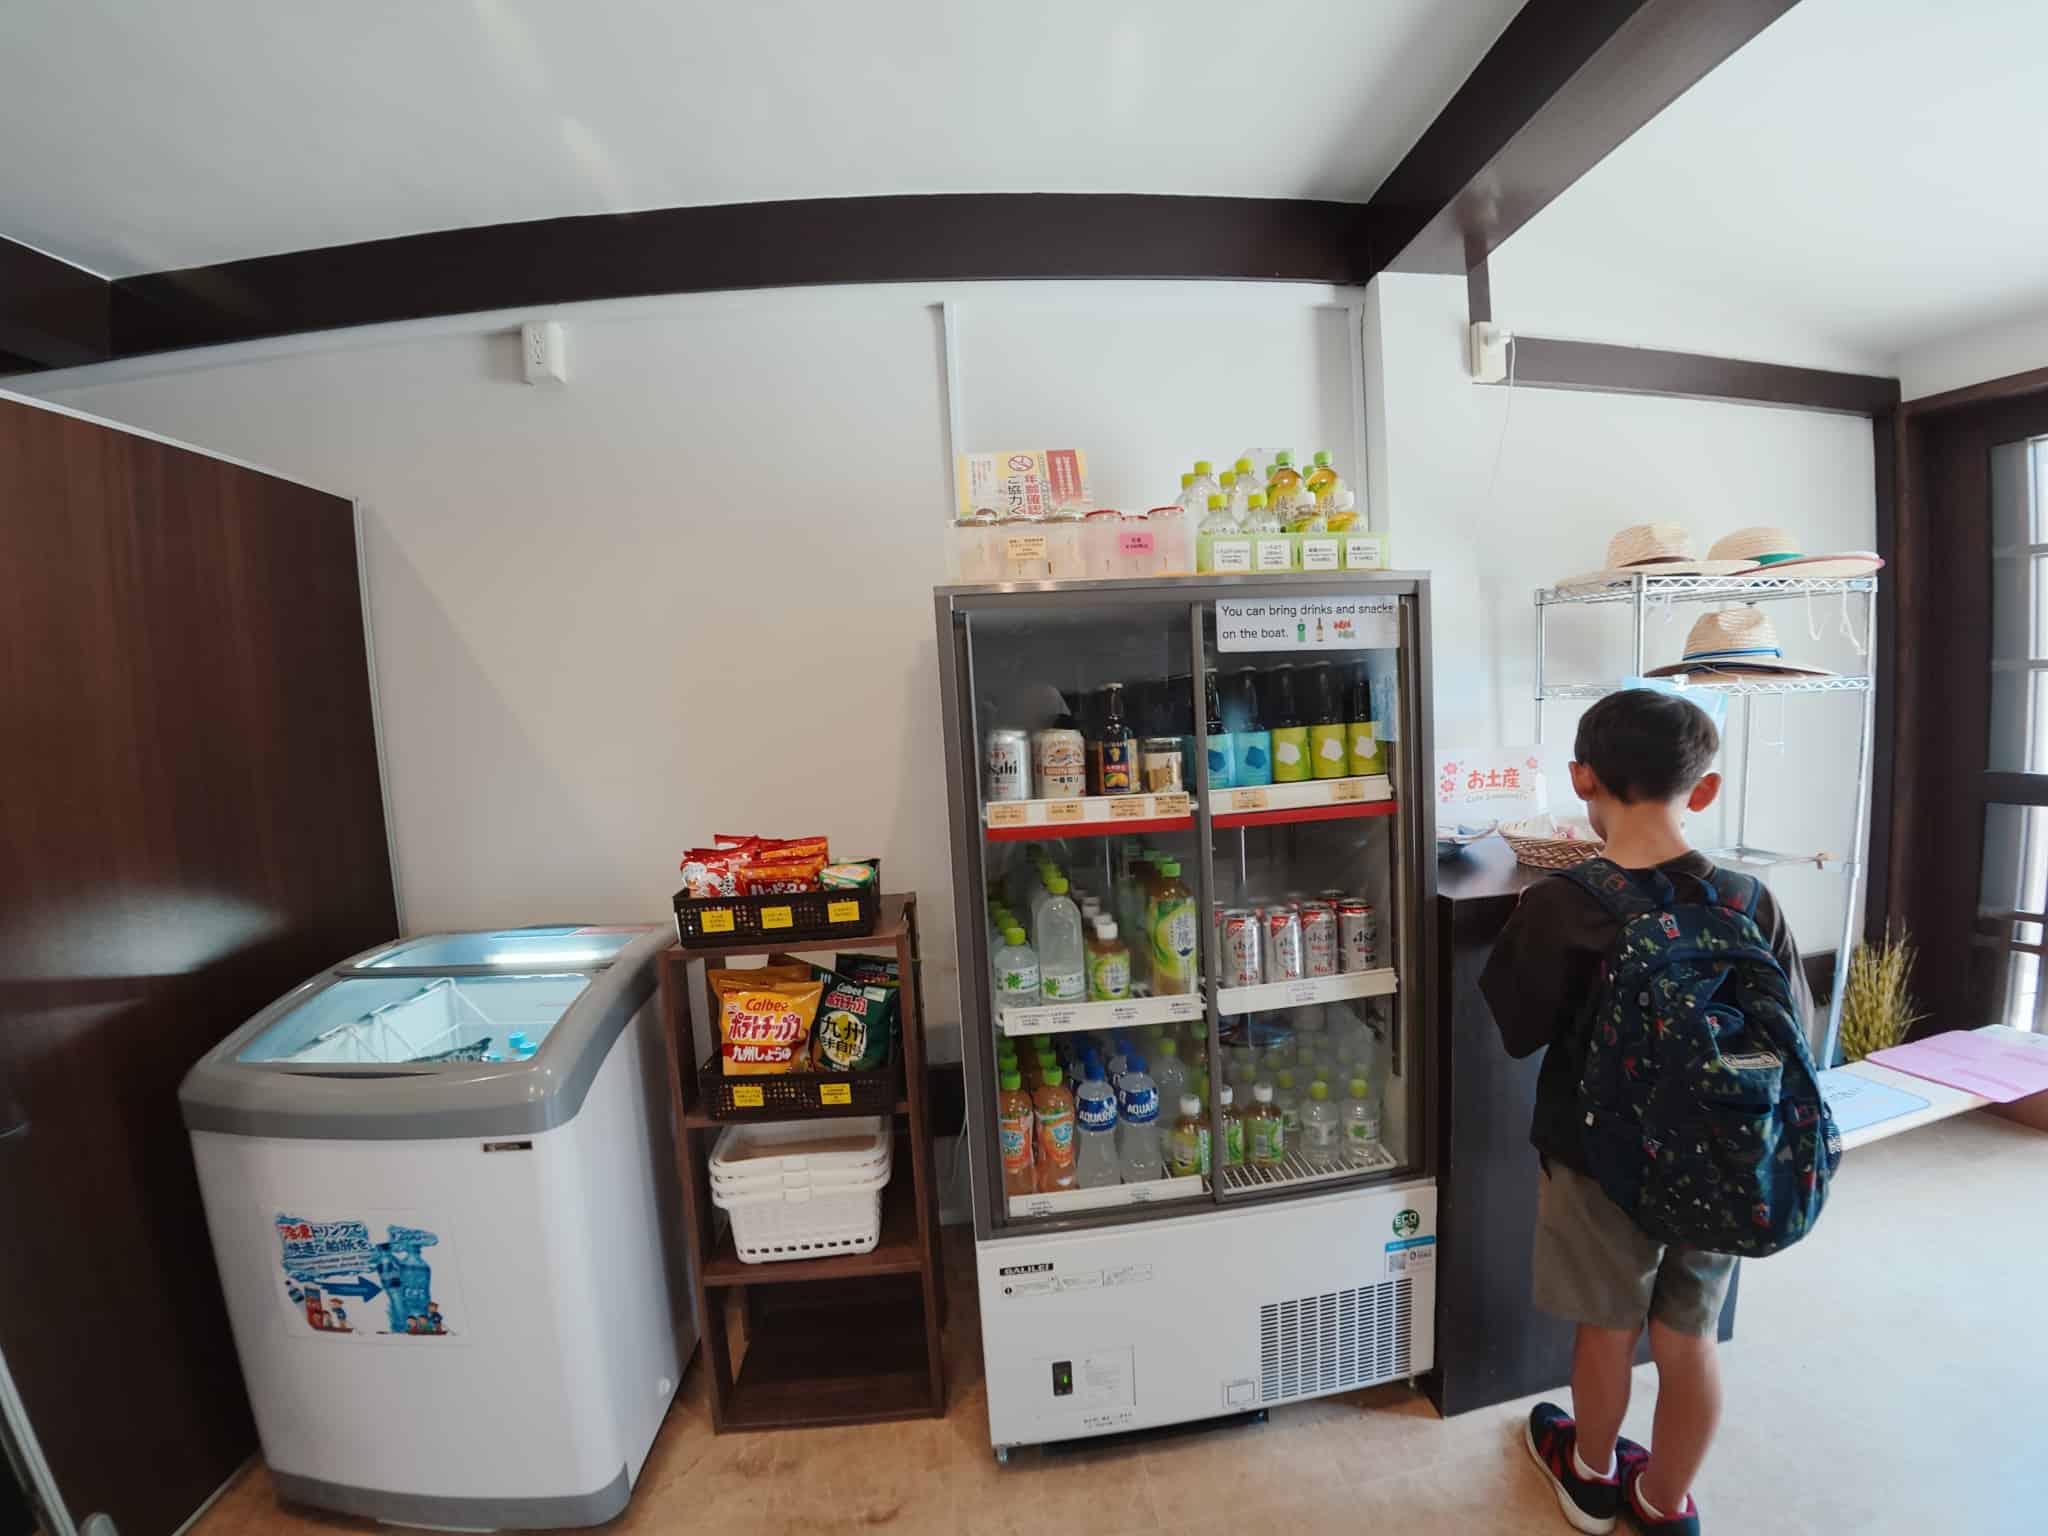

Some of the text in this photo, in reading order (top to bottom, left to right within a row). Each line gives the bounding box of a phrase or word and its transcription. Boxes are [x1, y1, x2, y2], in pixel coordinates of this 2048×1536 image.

[1222, 603, 1393, 618] You can bring drinks and snacks
[1222, 627, 1289, 640] on the boat.
[1467, 767, 1521, 790] お土産
[746, 998, 789, 1012] Calbee
[822, 1016, 866, 1044] 九州
